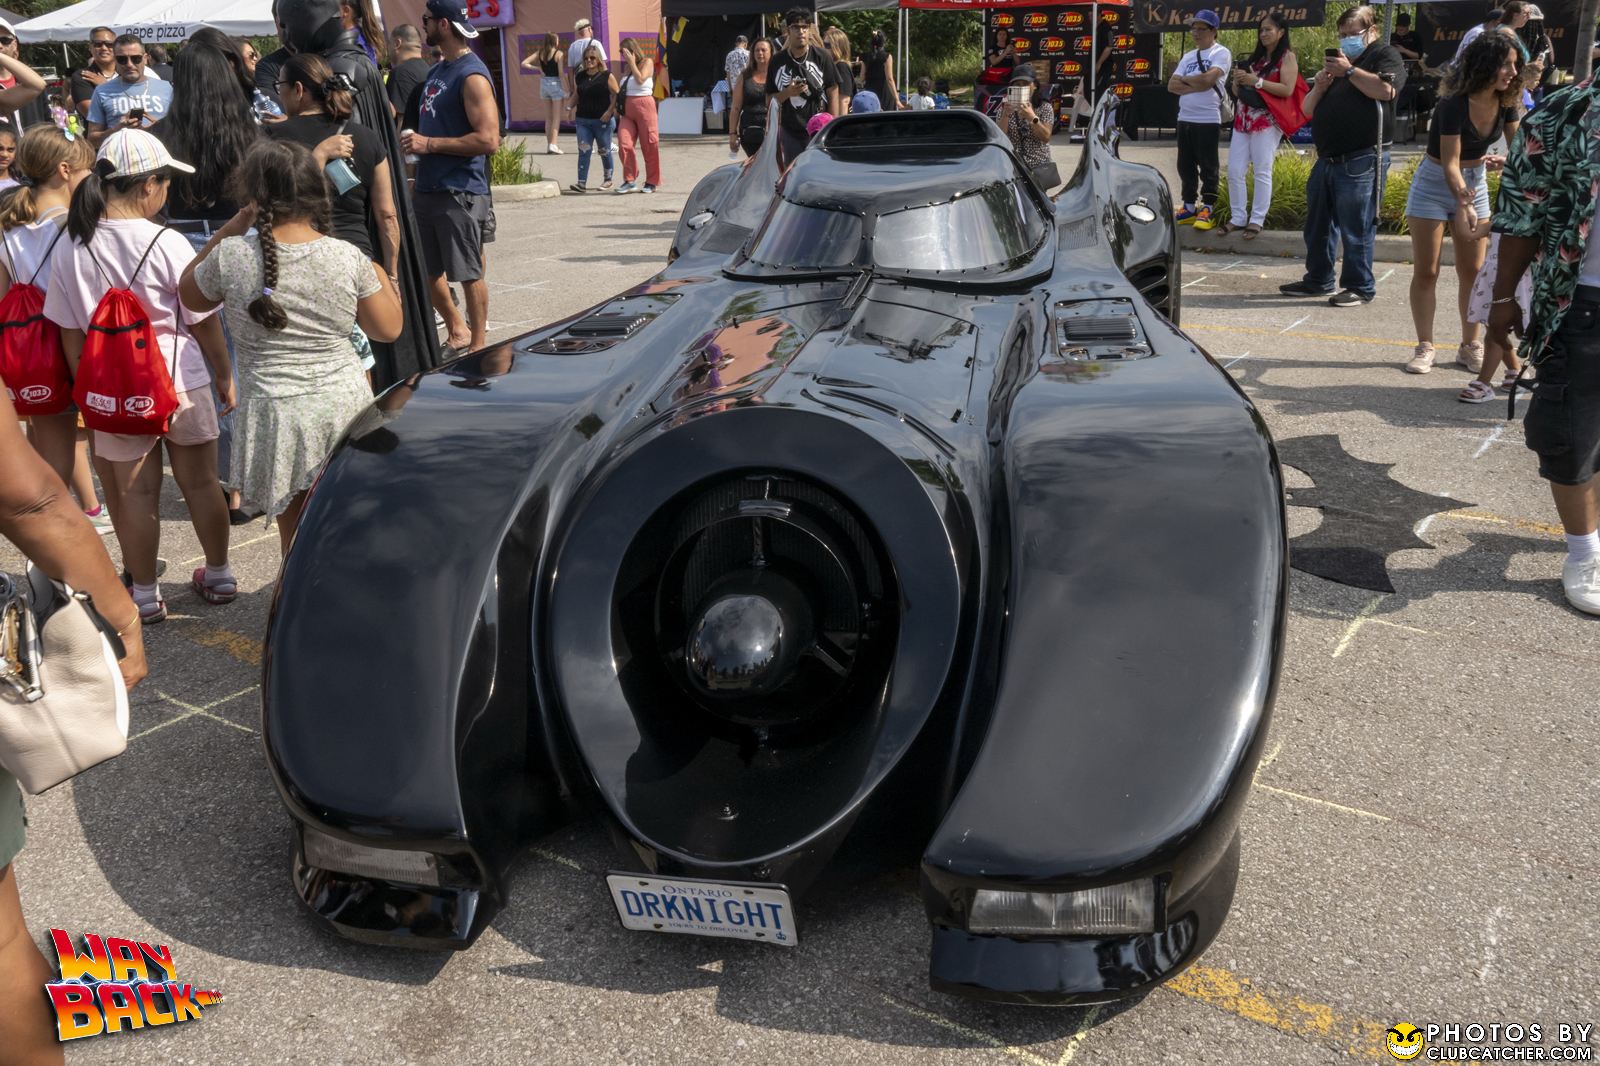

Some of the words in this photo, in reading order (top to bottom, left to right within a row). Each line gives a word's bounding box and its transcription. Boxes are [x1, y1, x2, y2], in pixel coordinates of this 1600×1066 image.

[157, 23, 185, 41] pizza
[111, 94, 164, 115] JONES
[662, 885, 733, 898] ONTARIO
[620, 890, 783, 930] DRKNIGHT
